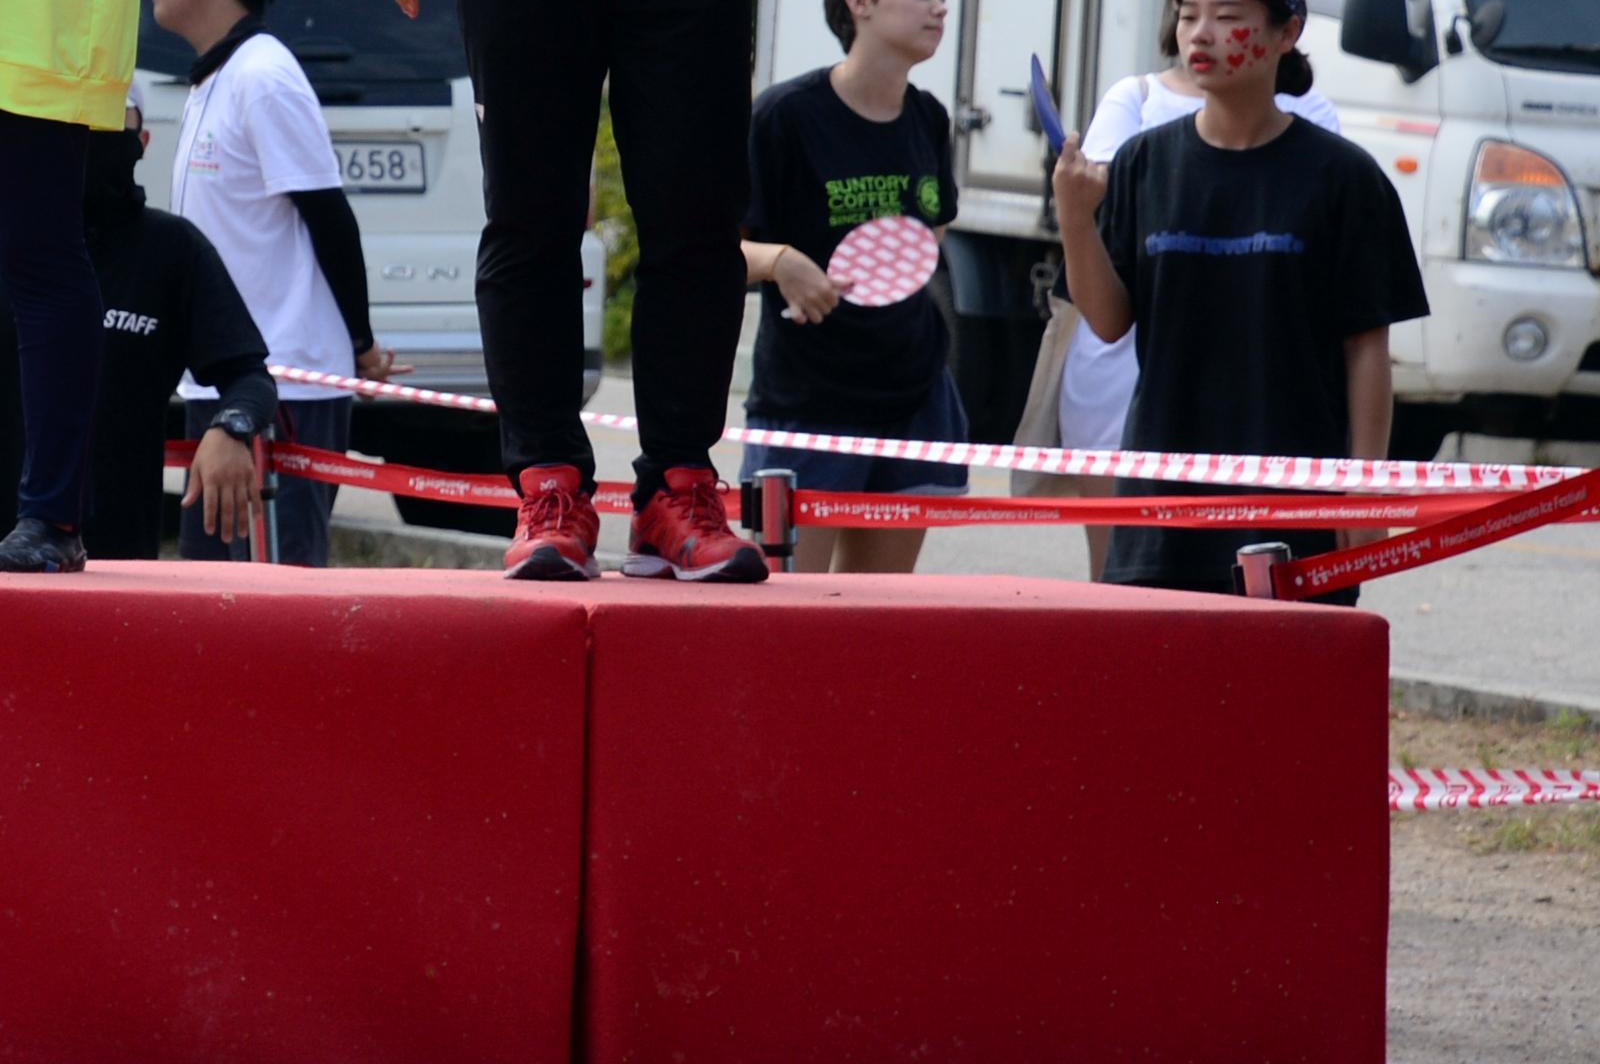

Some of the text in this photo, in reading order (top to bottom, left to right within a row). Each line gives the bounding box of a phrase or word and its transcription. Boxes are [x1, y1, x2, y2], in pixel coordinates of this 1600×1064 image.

[335, 148, 406, 181] 658
[825, 174, 911, 196] SUNTORY
[828, 191, 901, 210] COFFEE
[103, 308, 159, 336] STAFF
